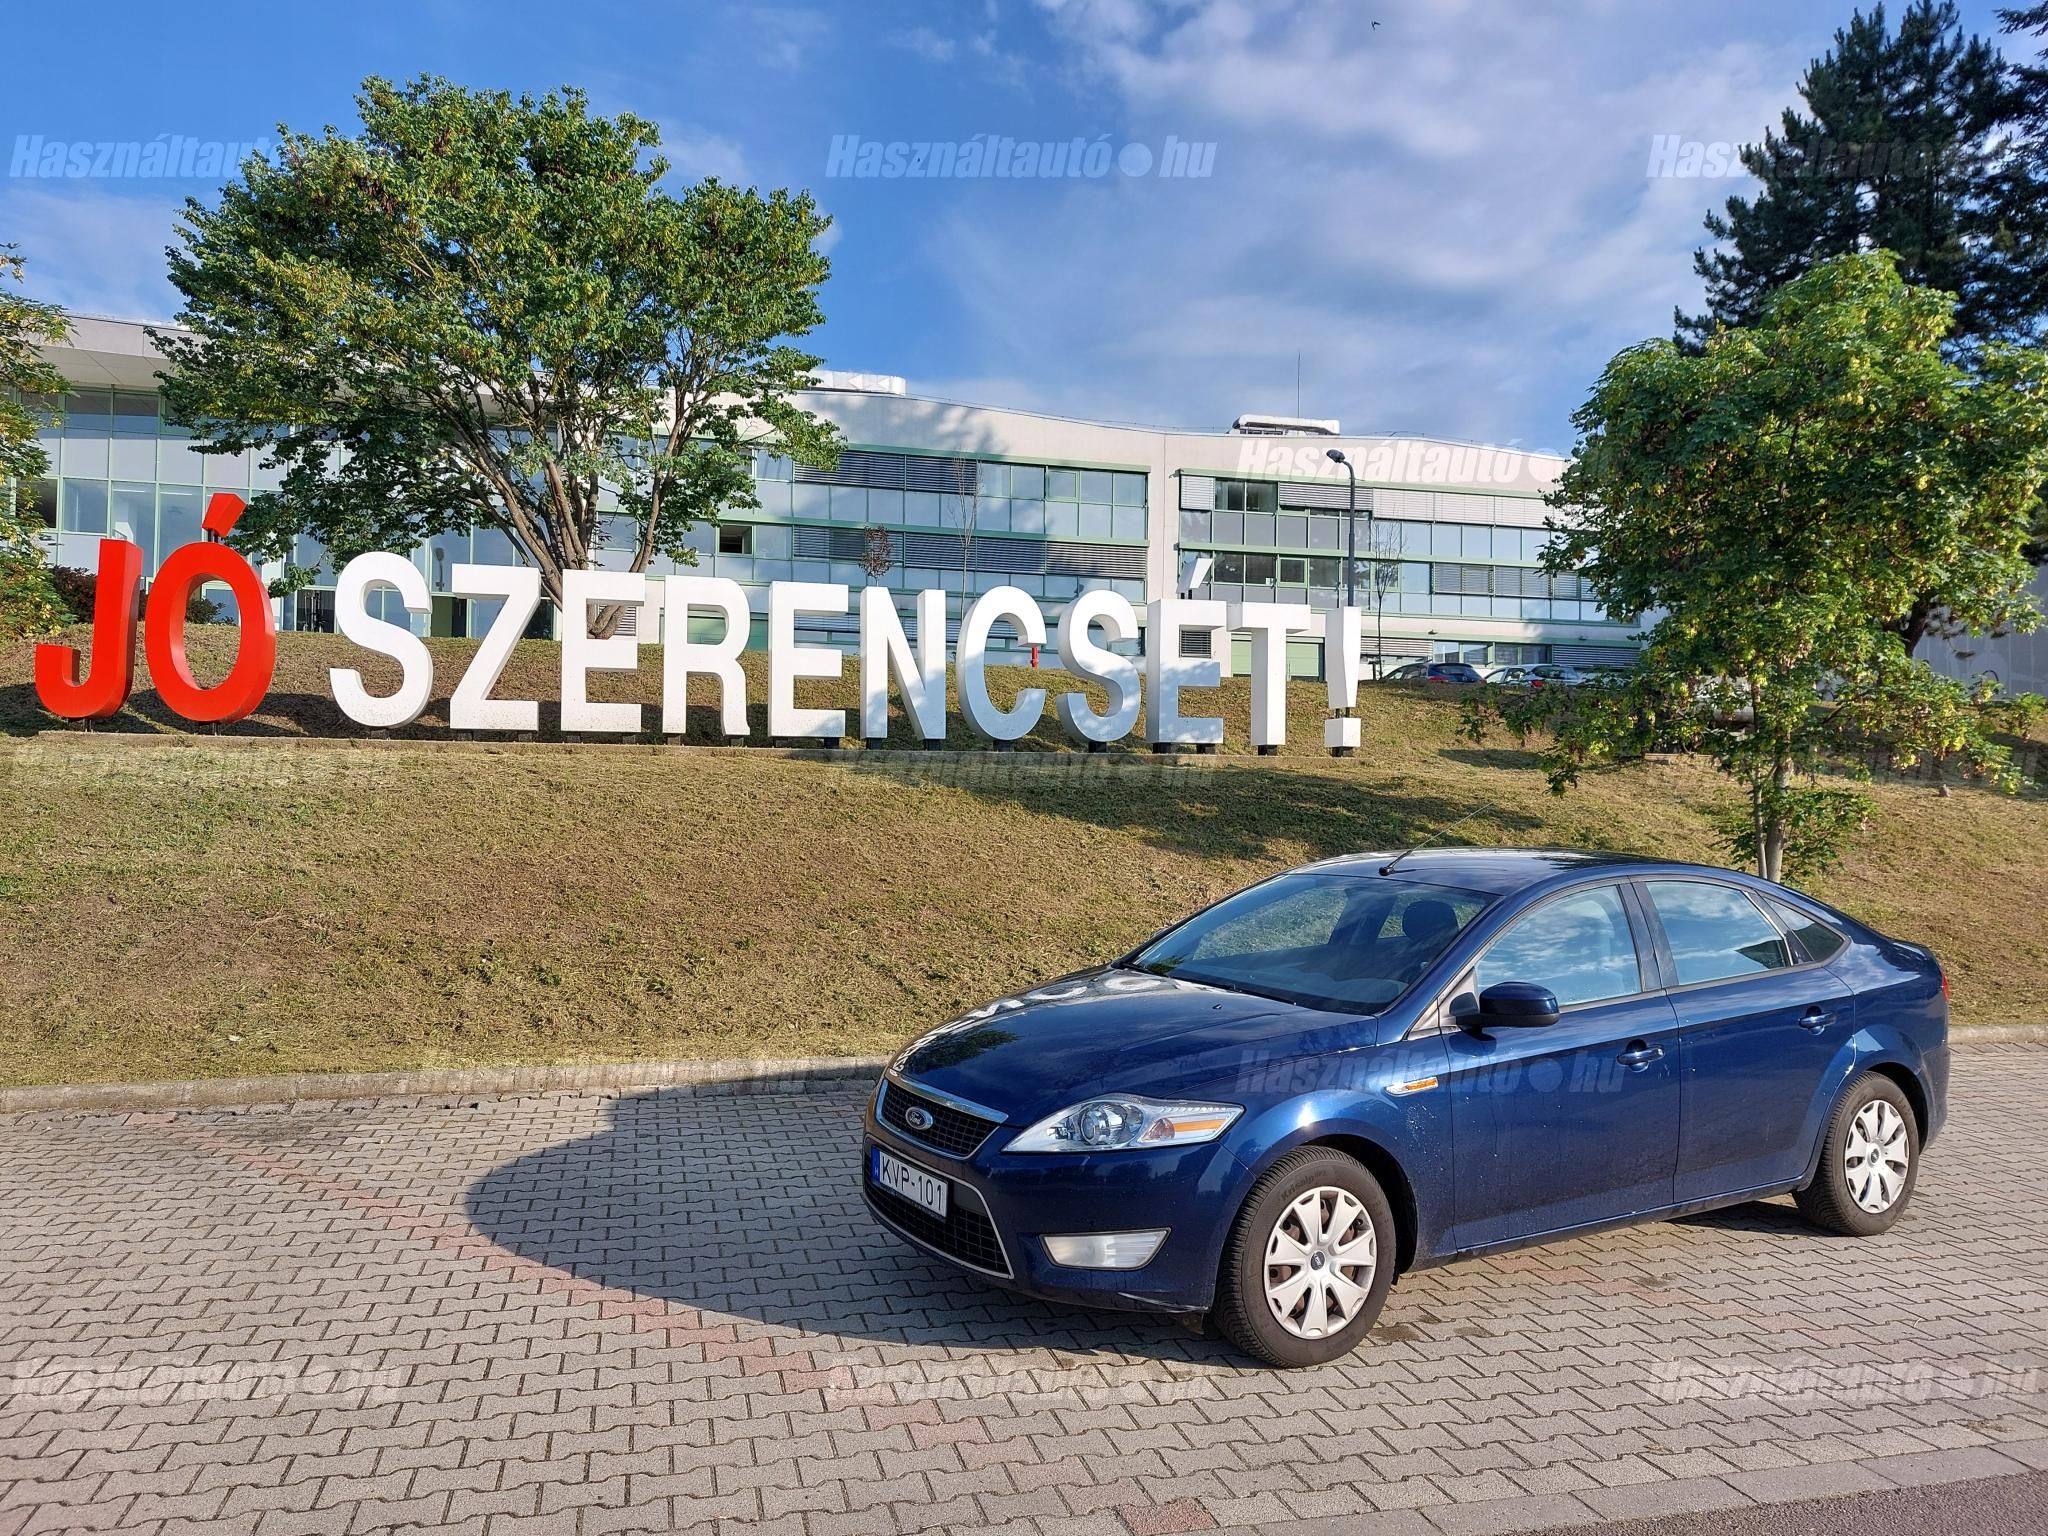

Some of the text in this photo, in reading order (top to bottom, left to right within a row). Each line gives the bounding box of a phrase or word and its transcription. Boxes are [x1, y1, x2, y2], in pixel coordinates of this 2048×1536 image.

[35, 492, 1362, 748] JÓ SZERENCSÉT!
[882, 1155, 942, 1211] KVP-101
